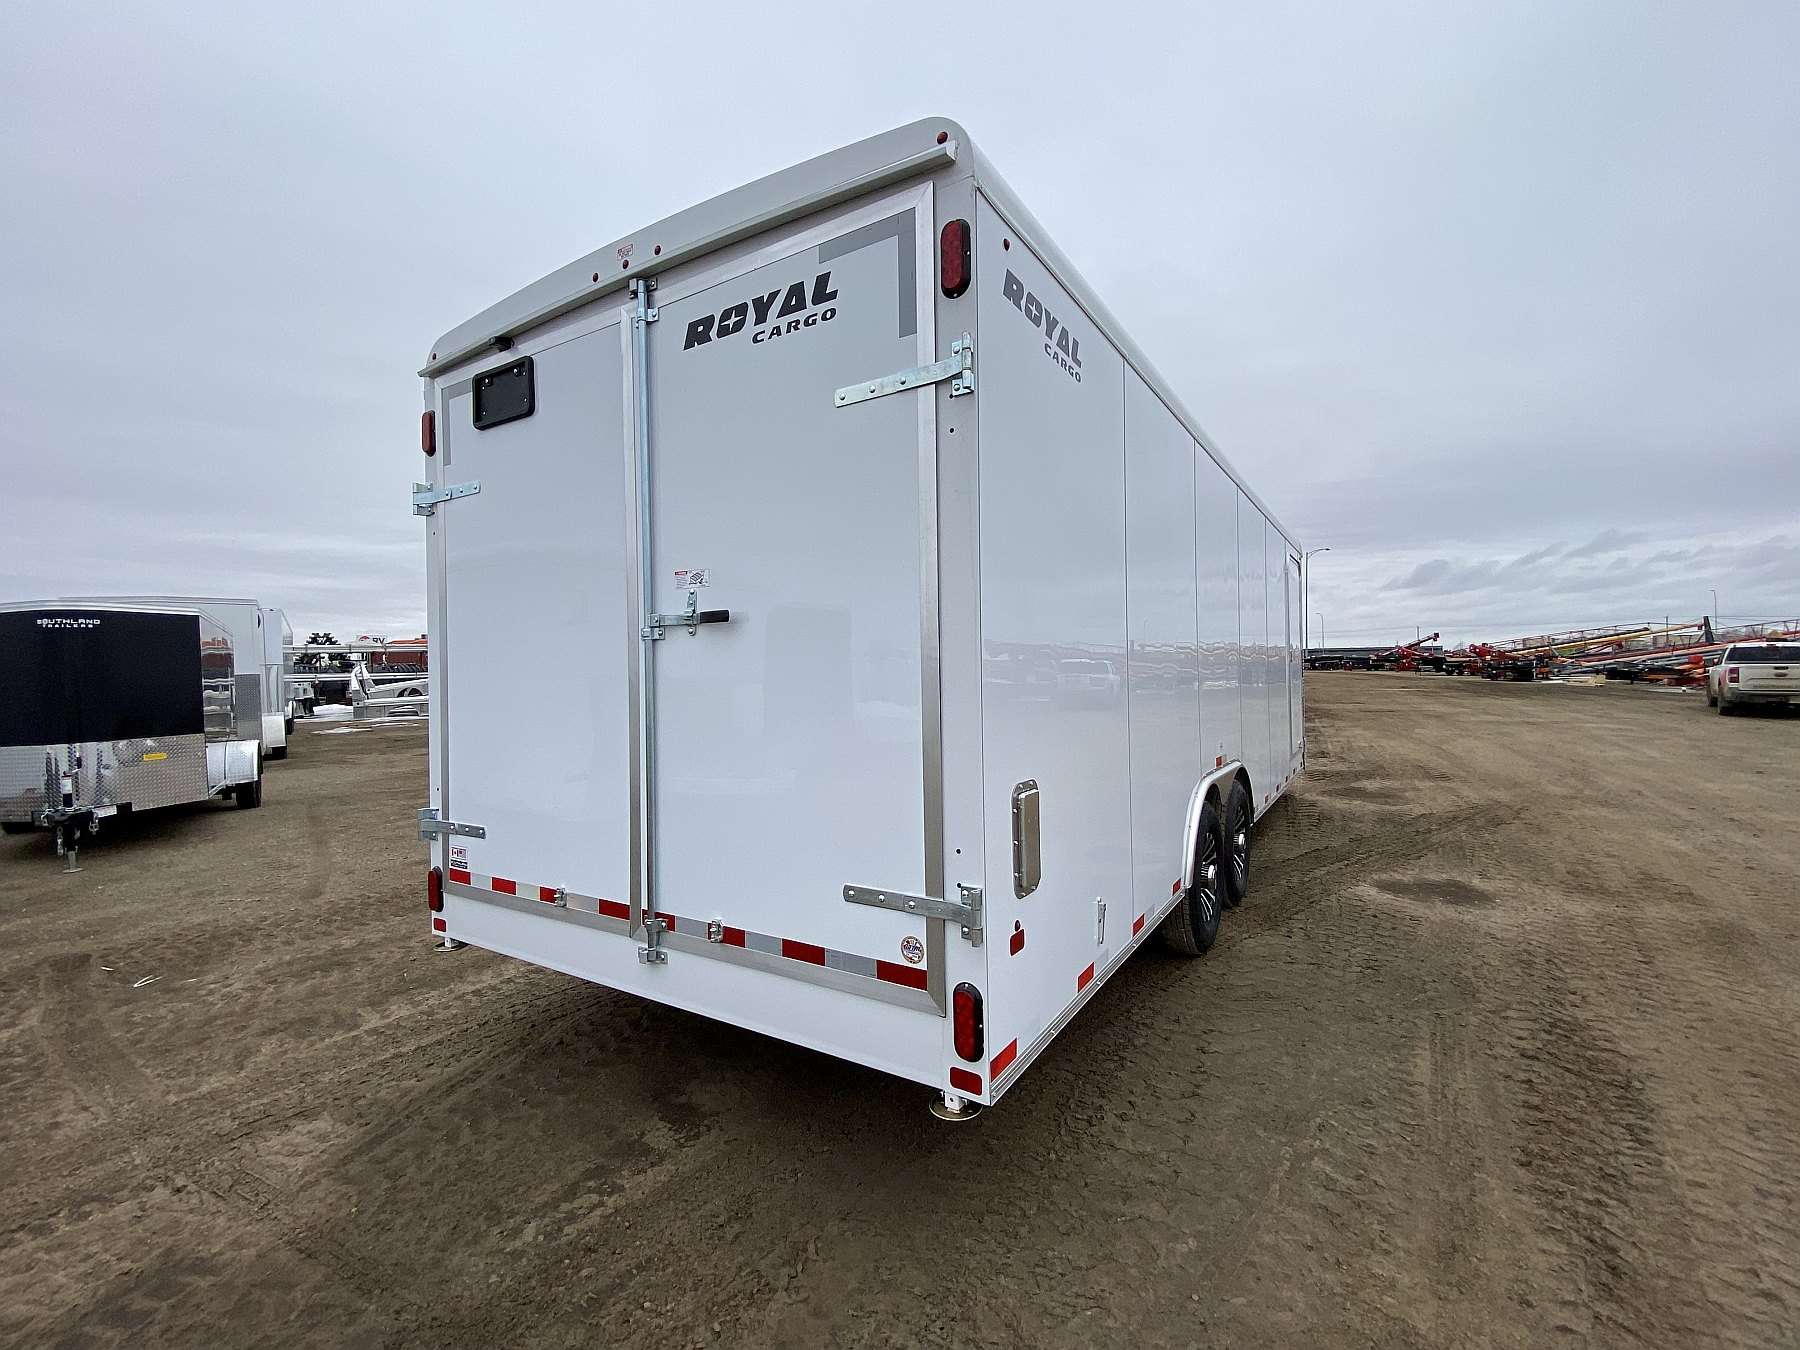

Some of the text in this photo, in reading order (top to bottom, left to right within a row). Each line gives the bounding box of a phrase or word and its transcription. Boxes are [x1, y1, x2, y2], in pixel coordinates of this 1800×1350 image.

[683, 271, 839, 351] ROYAL
[752, 307, 838, 344] CARGO
[1002, 268, 1083, 369] ROYAL
[1044, 343, 1082, 384] CARGO
